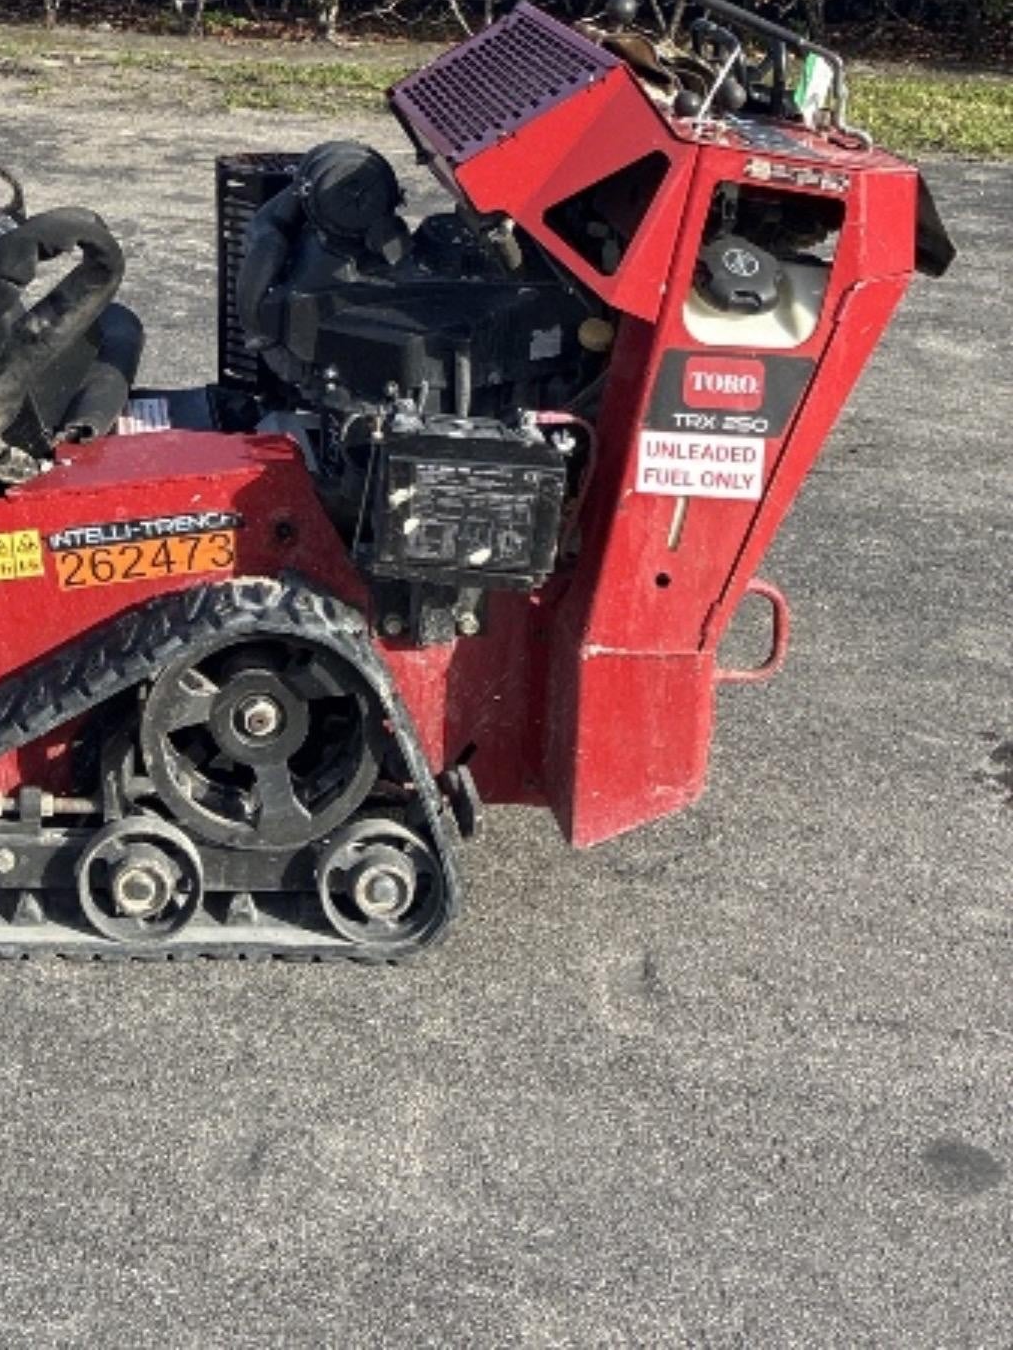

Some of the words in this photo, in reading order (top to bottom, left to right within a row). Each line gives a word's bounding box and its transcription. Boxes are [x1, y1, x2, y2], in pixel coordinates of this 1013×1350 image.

[691, 370, 761, 395] TORO
[672, 412, 717, 430] TRX
[721, 414, 769, 433] 250
[646, 440, 757, 464] UNLEADED
[643, 467, 694, 488] FUEL
[700, 469, 756, 490] ONLY
[61, 533, 235, 586] 262473
